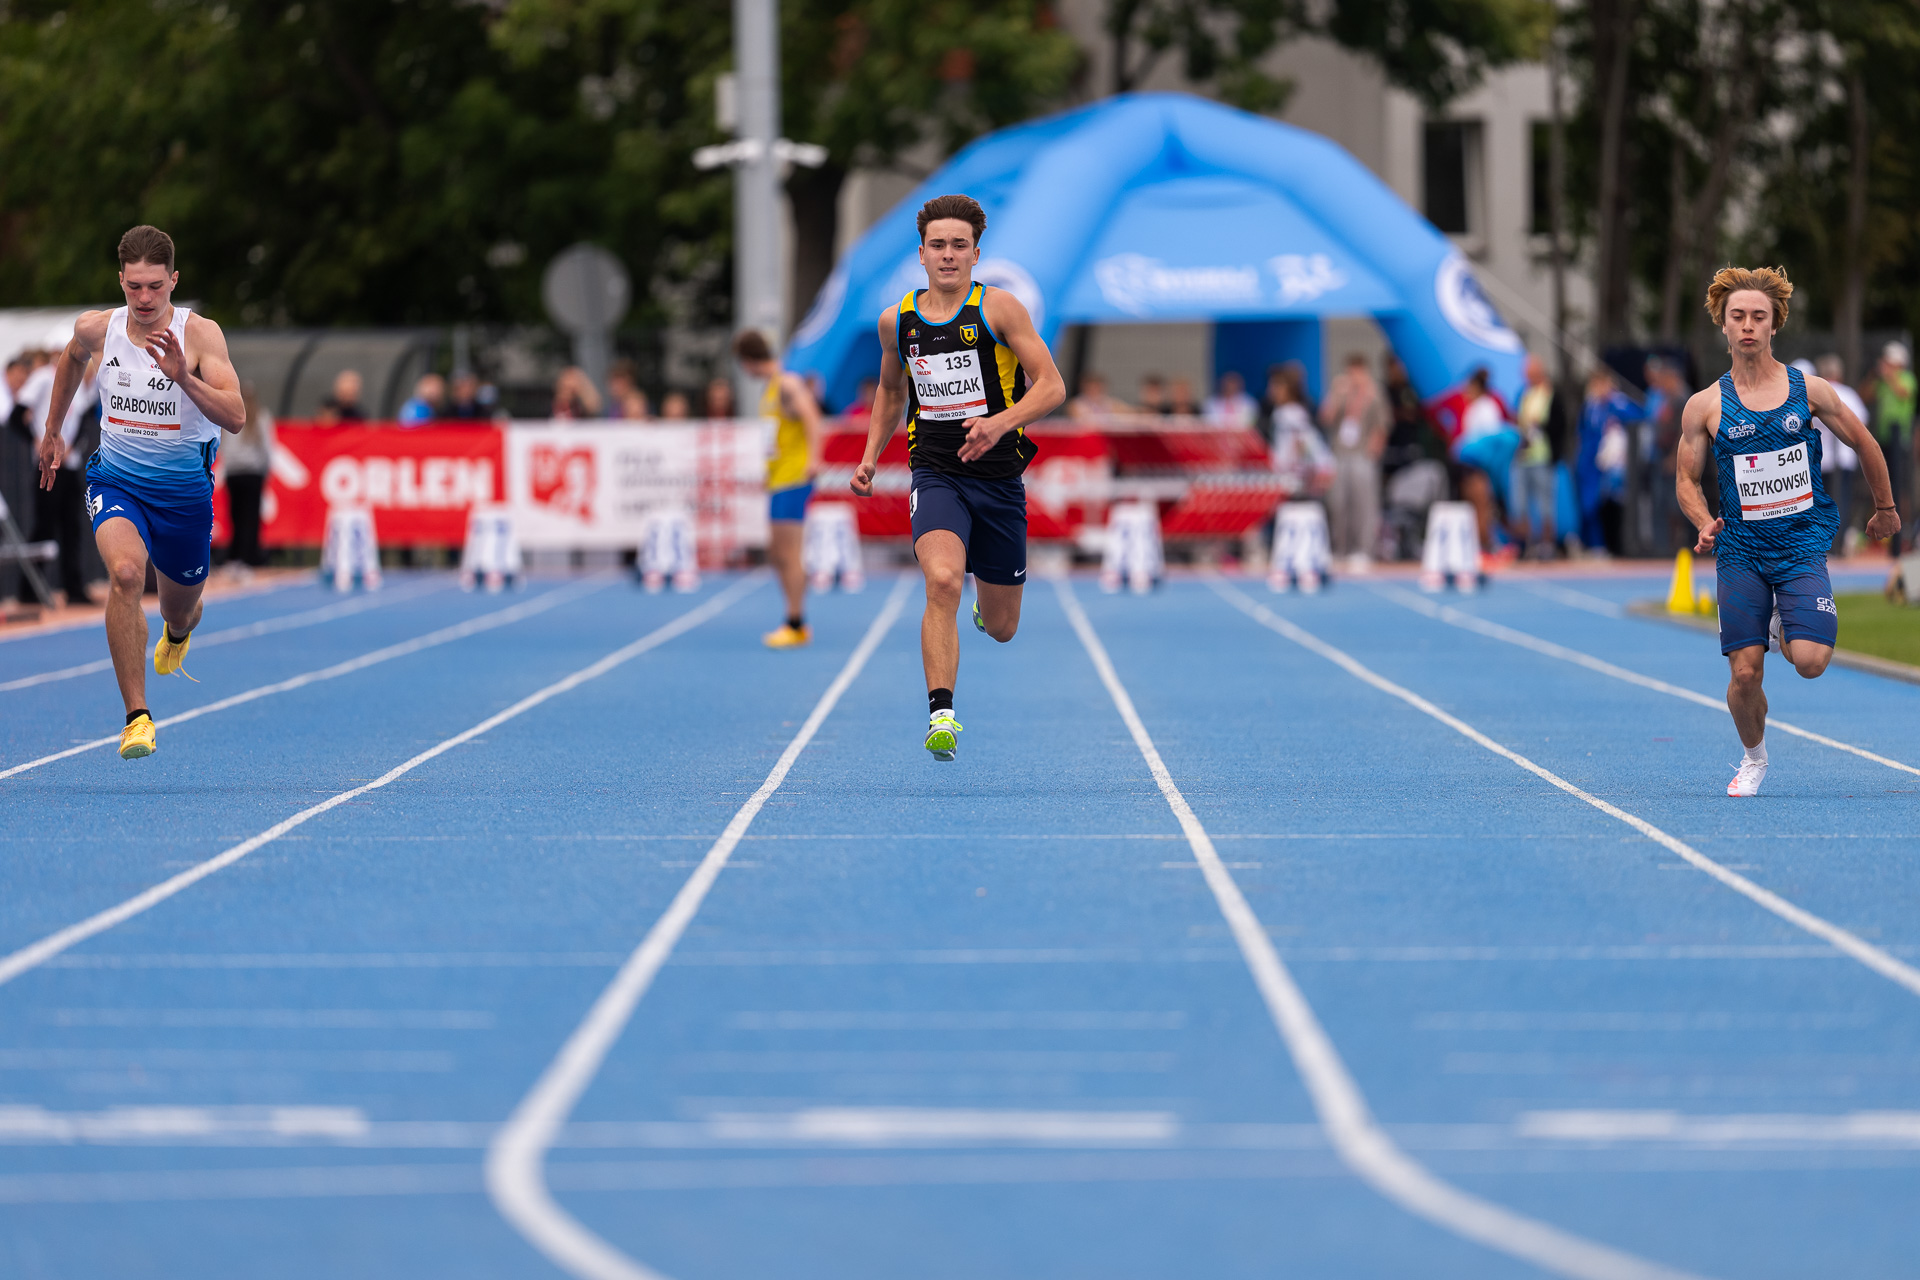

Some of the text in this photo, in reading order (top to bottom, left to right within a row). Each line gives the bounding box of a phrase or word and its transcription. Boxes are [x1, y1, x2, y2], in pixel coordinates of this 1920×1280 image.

[944, 354, 972, 371] 135
[147, 377, 175, 391] 467
[917, 376, 981, 398] OLEJNICZAK
[110, 394, 176, 416] GRABOWSKI
[950, 410, 967, 418] 2026
[123, 427, 159, 437] LUBIN 2026
[1777, 448, 1803, 467] 540
[320, 455, 494, 509] ORLEN
[1739, 469, 1809, 497] IRZYKOWSKI
[1762, 505, 1798, 517] LUBIN 2026
